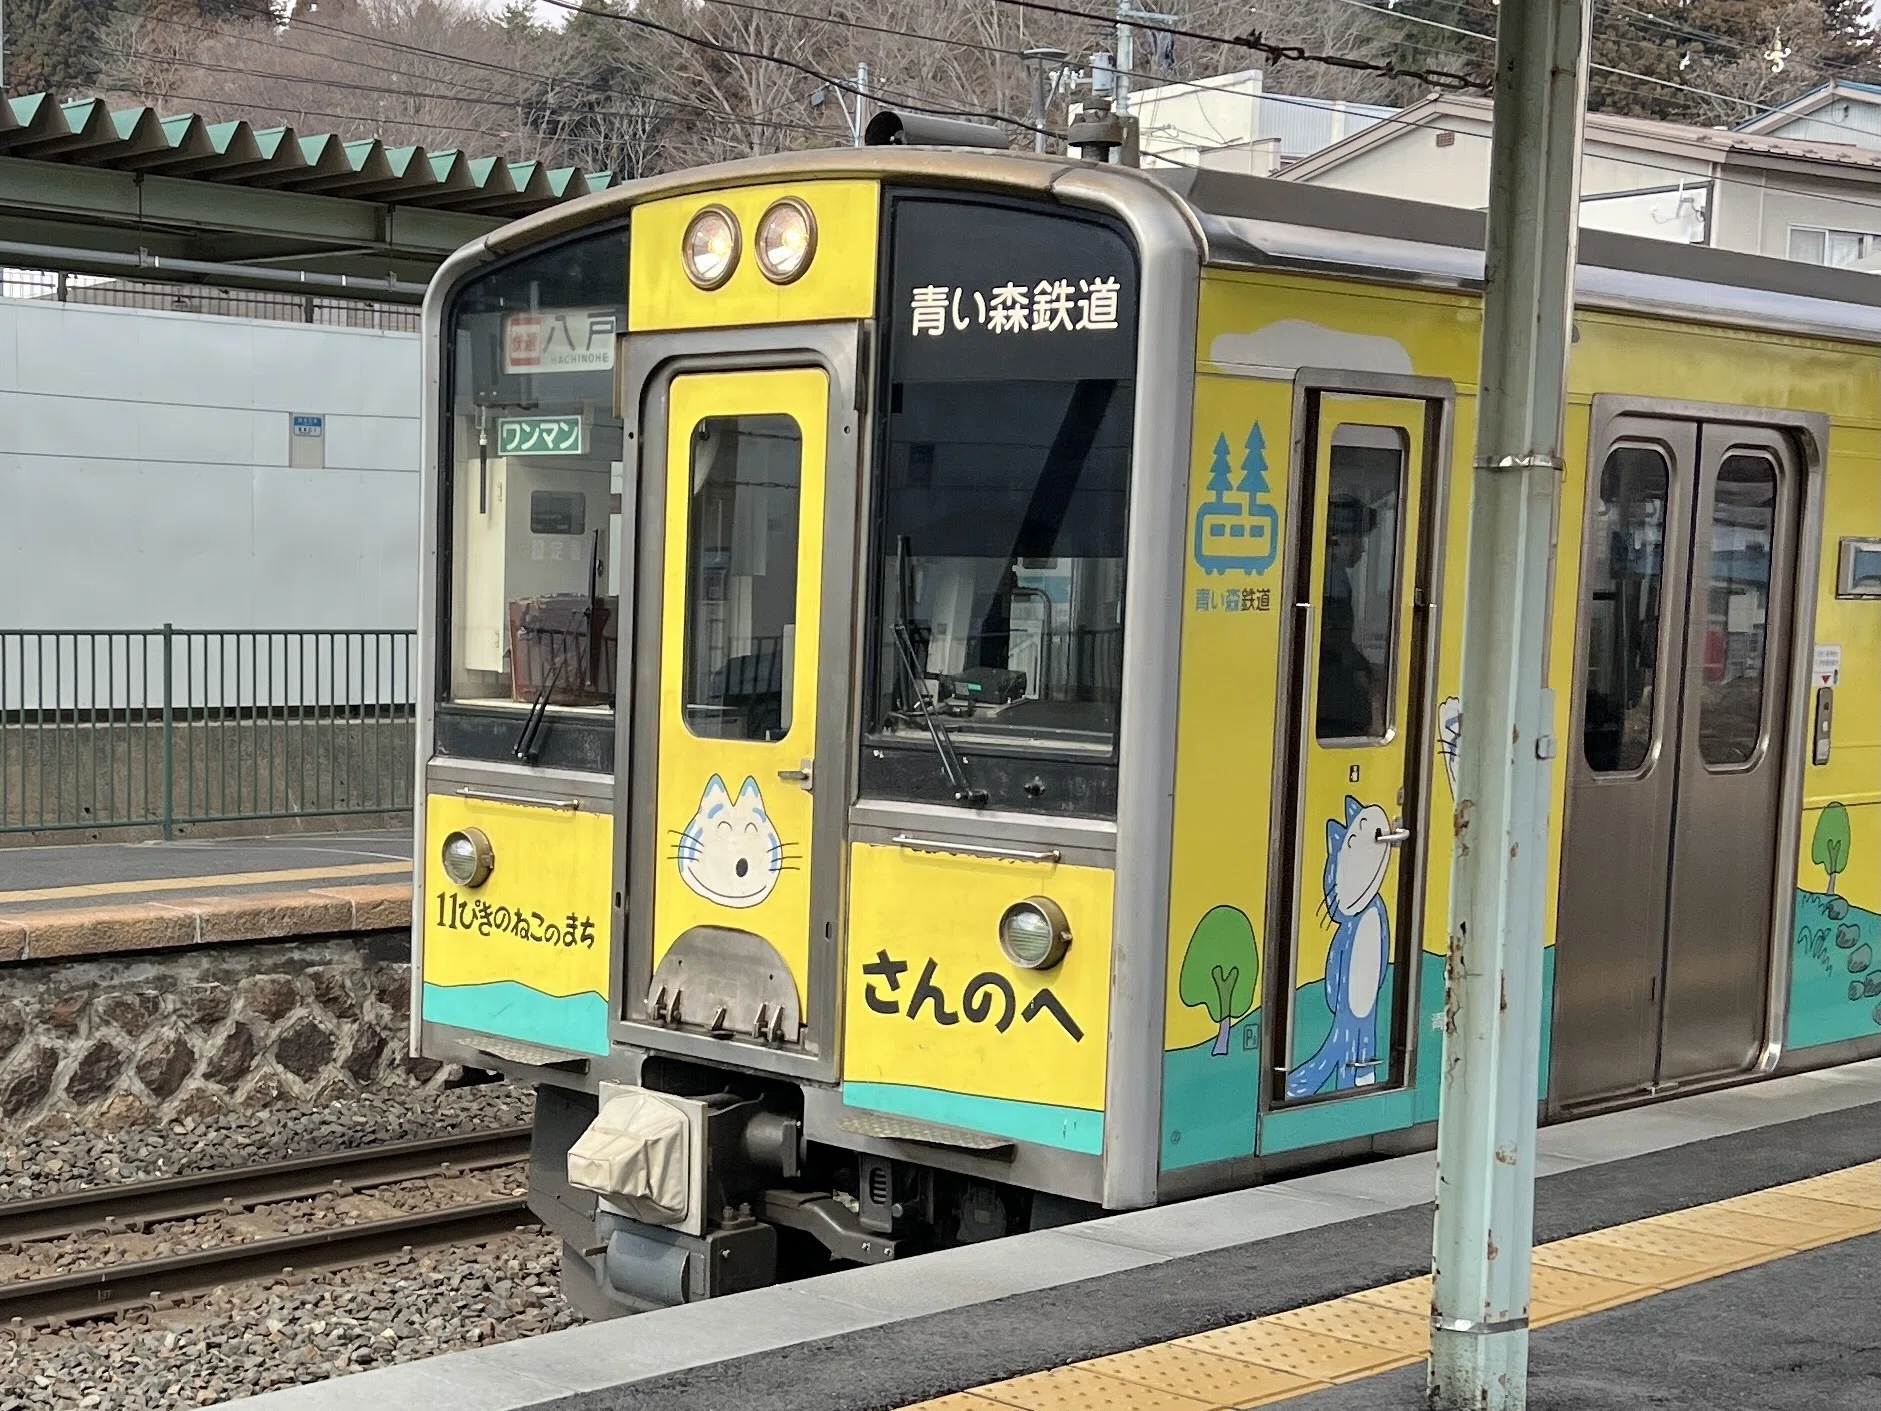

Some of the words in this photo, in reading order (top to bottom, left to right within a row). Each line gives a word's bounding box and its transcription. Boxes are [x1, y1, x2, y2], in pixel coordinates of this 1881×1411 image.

[911, 276, 1120, 336] 青い森鉄道
[543, 312, 616, 353] 八戸
[550, 353, 608, 364] HACHINOHE
[502, 421, 578, 450] ワンマン
[1195, 588, 1271, 611] 青い森鉄道
[437, 891, 595, 949] 11ぴきのねこのまち
[862, 949, 1084, 1043] さんのへ
